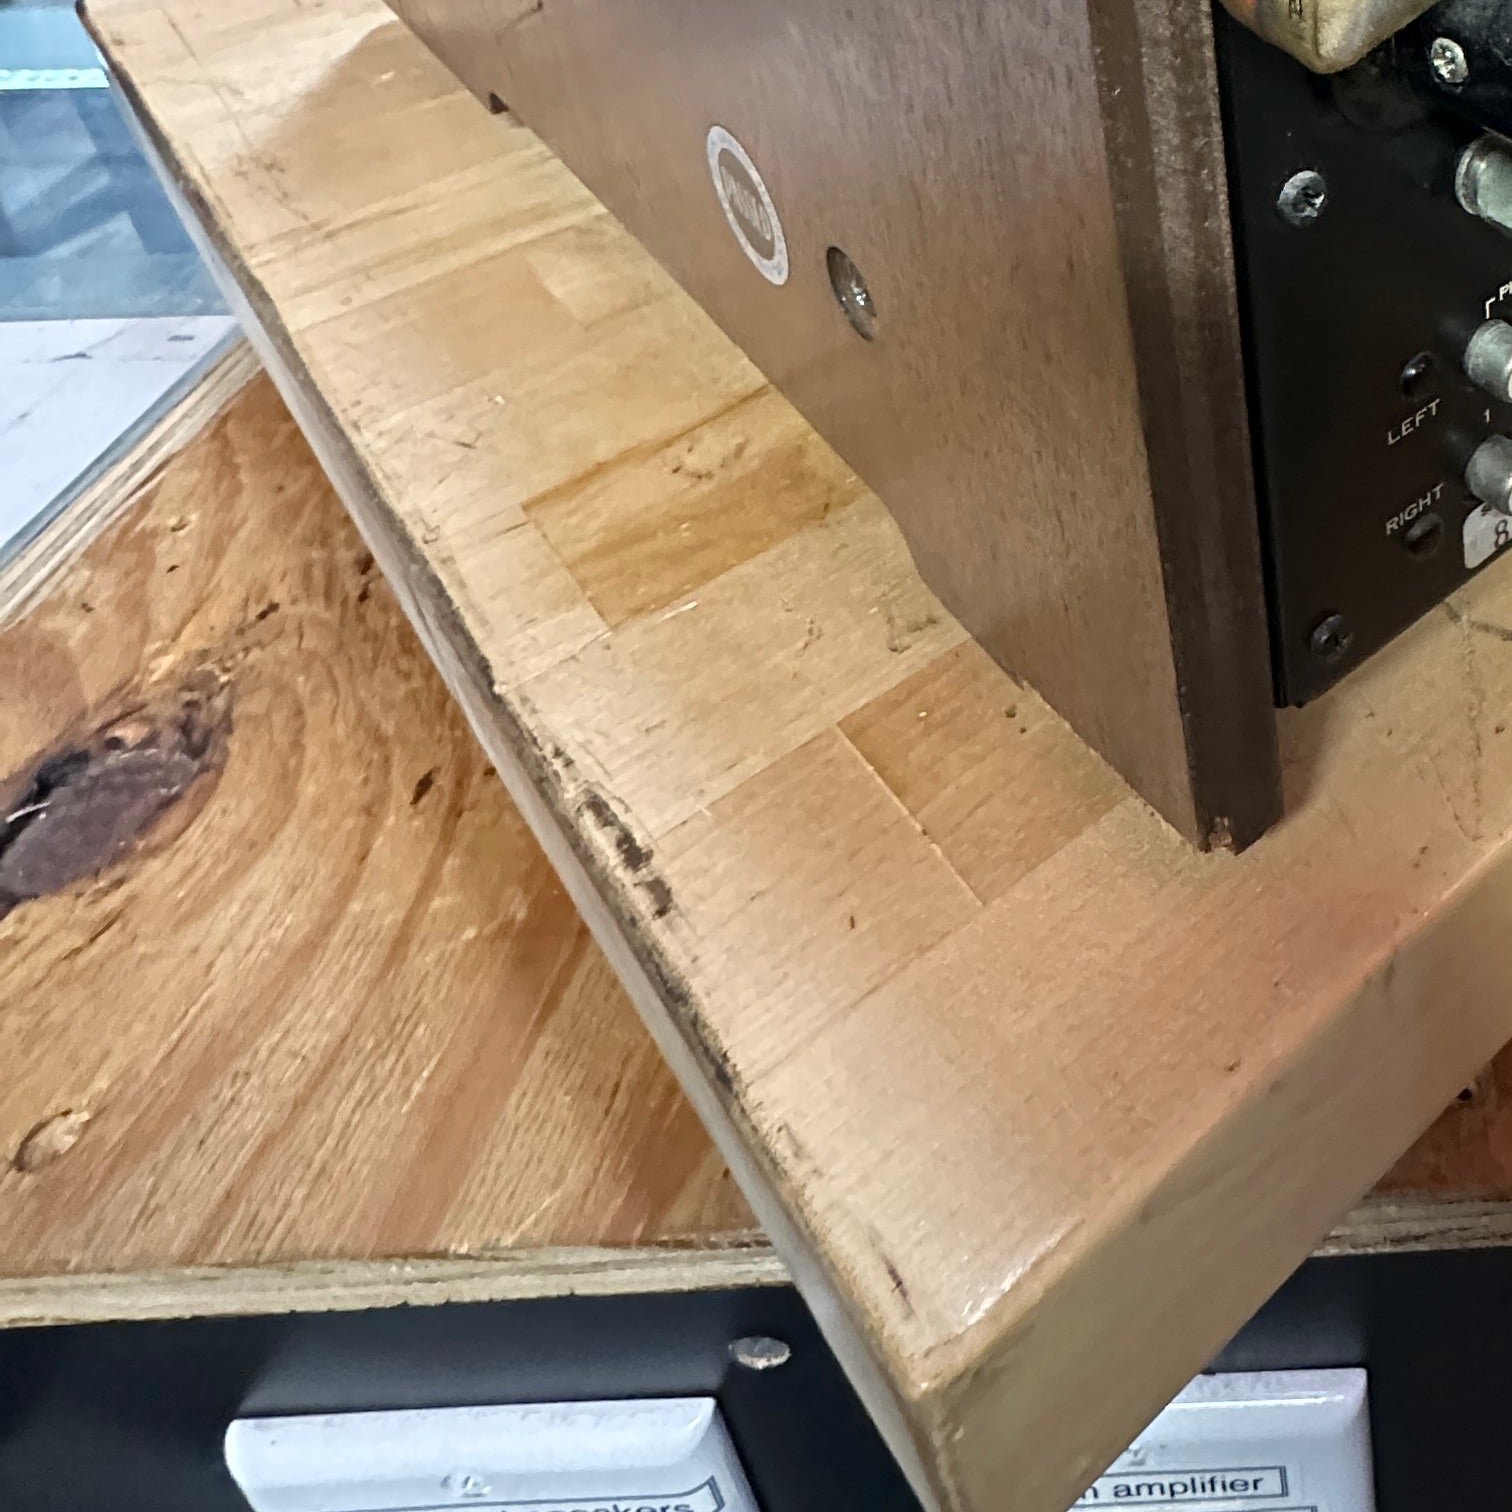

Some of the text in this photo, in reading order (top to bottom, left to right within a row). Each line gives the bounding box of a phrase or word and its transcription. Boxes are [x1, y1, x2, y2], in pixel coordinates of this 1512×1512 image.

[1386, 398, 1441, 446] LEFT
[1483, 407, 1492, 424] 1
[1385, 482, 1444, 536] RIGHT
[1113, 1473, 1264, 1500] amplifier
